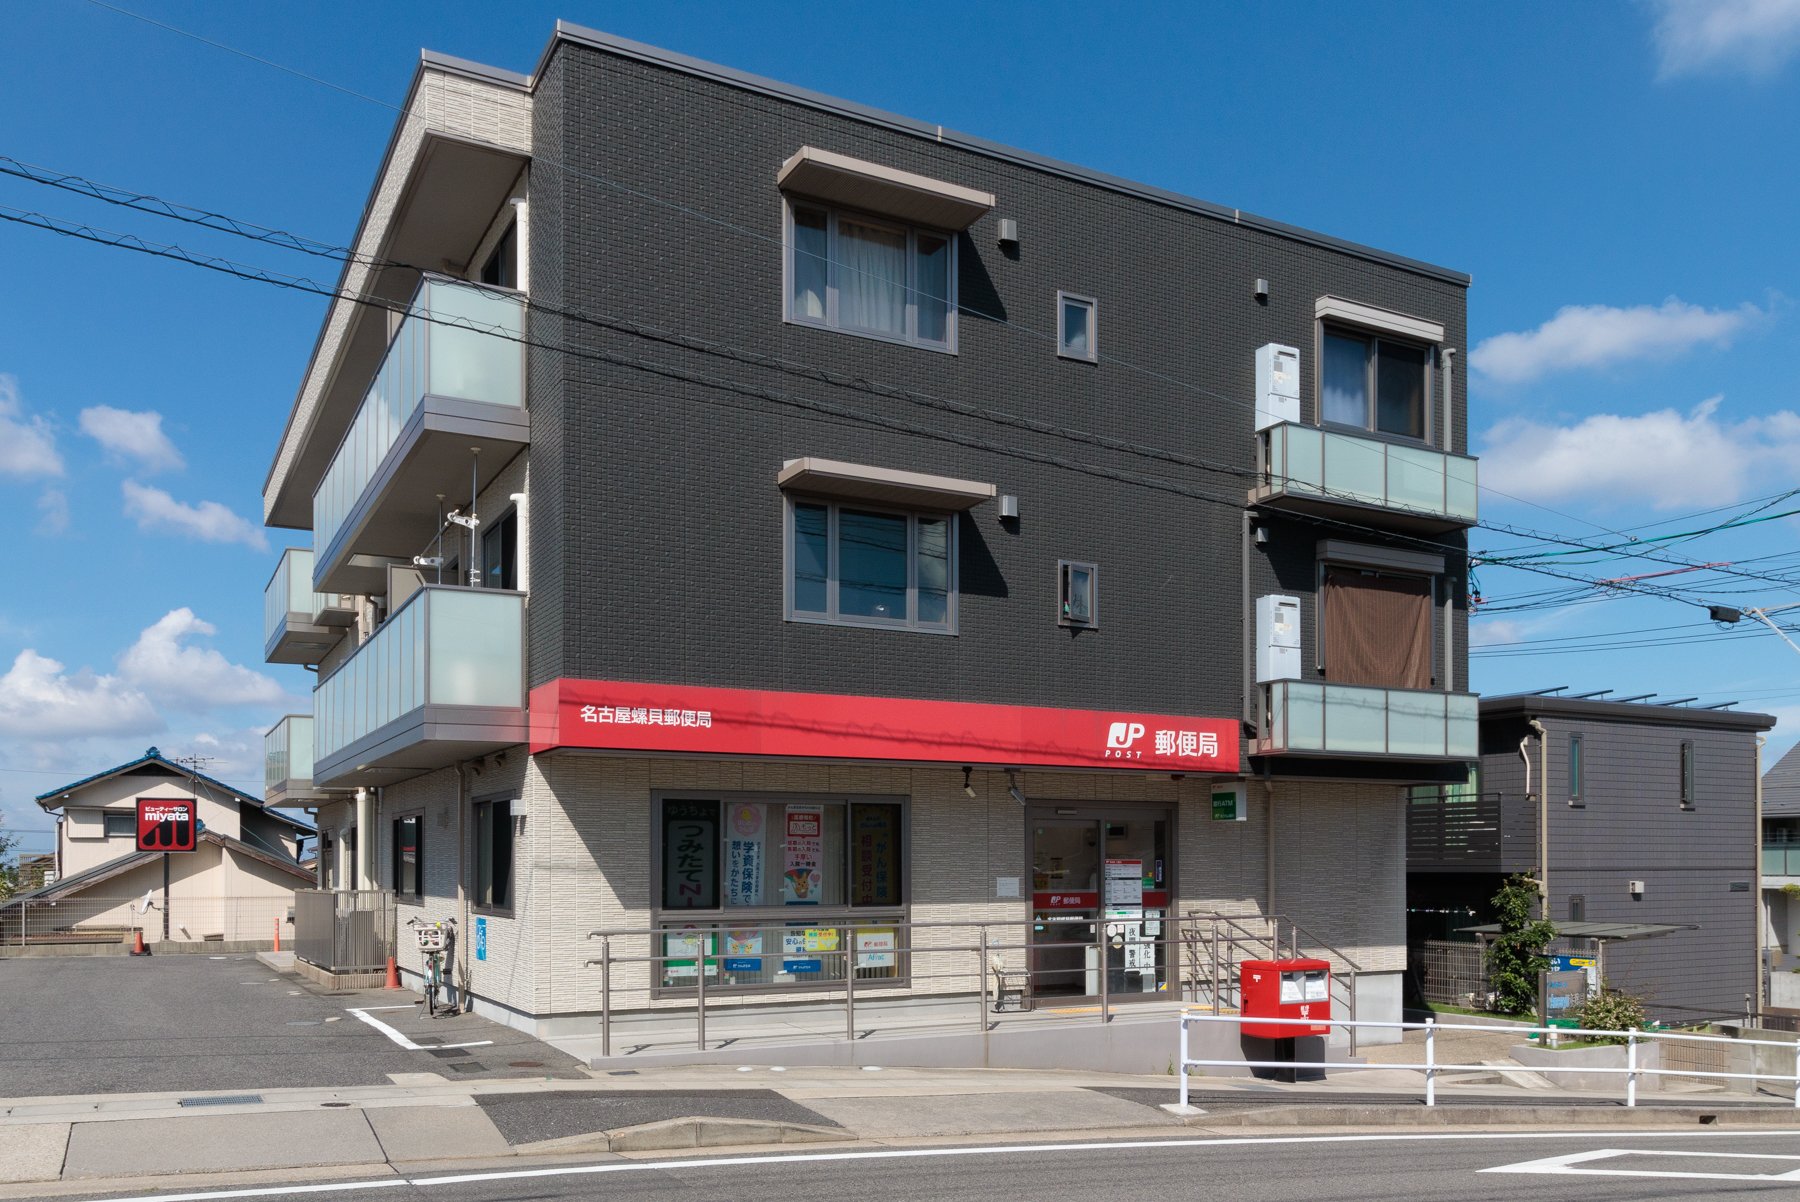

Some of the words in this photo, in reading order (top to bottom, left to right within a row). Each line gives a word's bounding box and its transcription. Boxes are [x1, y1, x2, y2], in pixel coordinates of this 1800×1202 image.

[580, 704, 712, 728] 名古屋螺貝郵便局
[1106, 722, 1145, 748] JP
[1155, 730, 1218, 757] 郵便局
[1105, 750, 1142, 758] POST
[145, 811, 189, 822] miyata
[730, 840, 741, 905] 想いをかたちに
